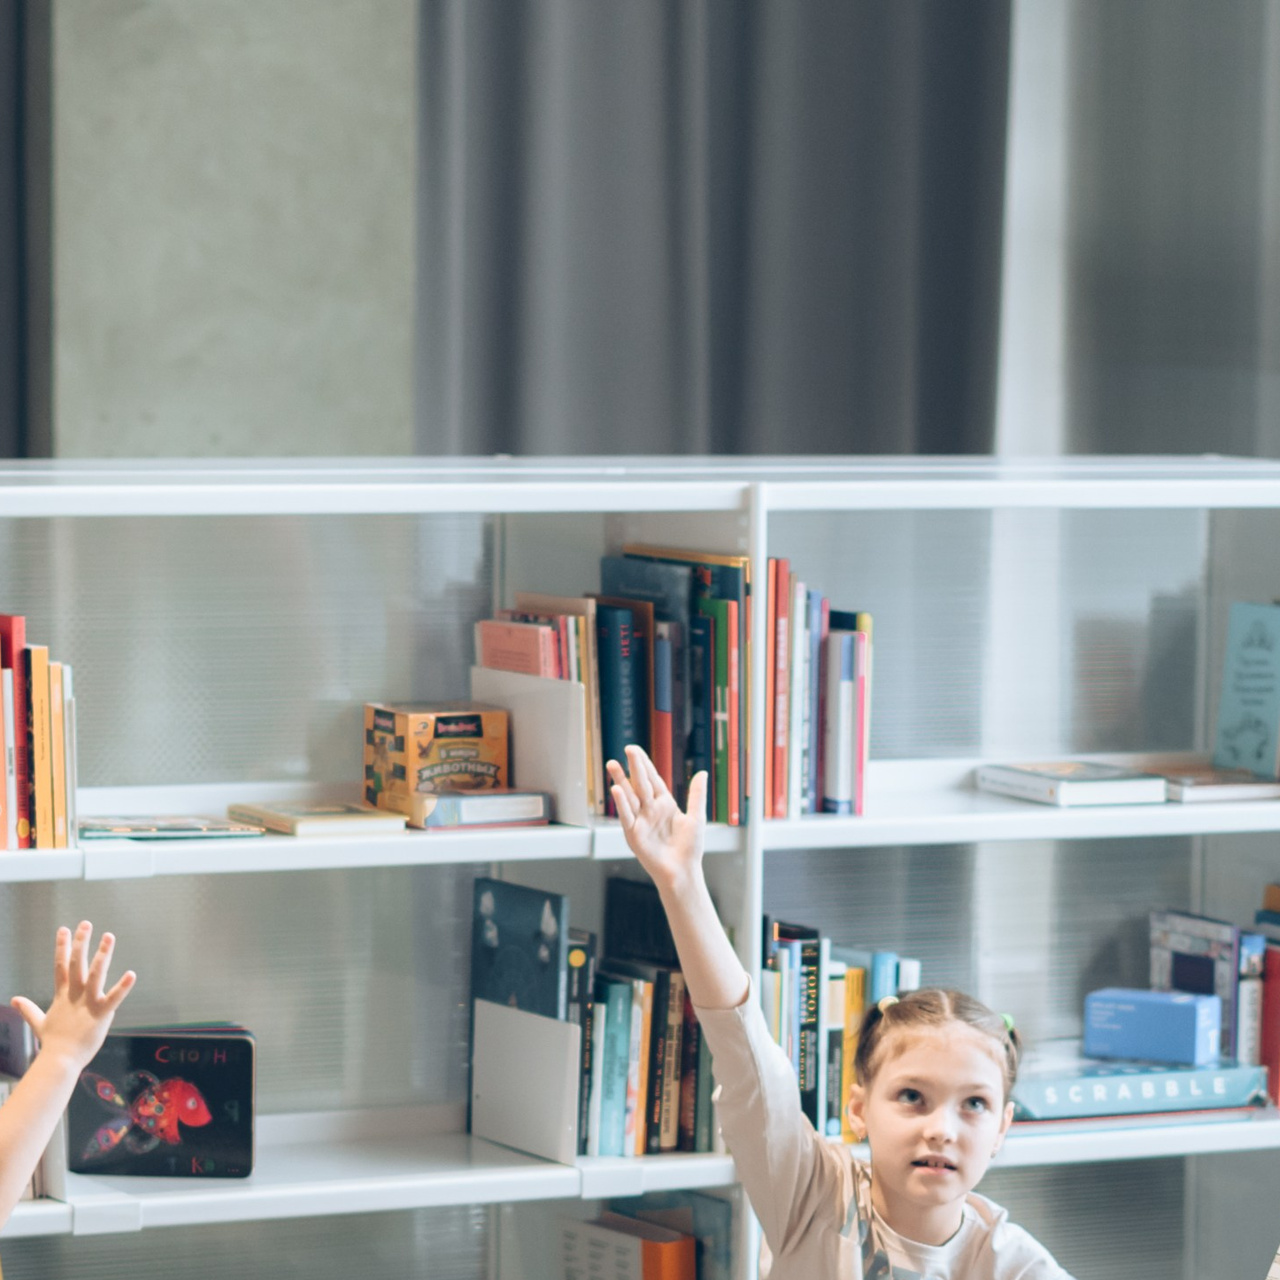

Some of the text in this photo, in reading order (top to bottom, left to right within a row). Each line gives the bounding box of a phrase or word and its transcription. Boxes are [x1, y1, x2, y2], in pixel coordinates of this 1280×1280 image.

[620, 624, 630, 657] НЕТ!
[421, 762, 497, 779] ЖИВОТНЫХ
[806, 965, 817, 1023] ГОРОД
[1045, 1077, 1227, 1104] SCRABBLE
